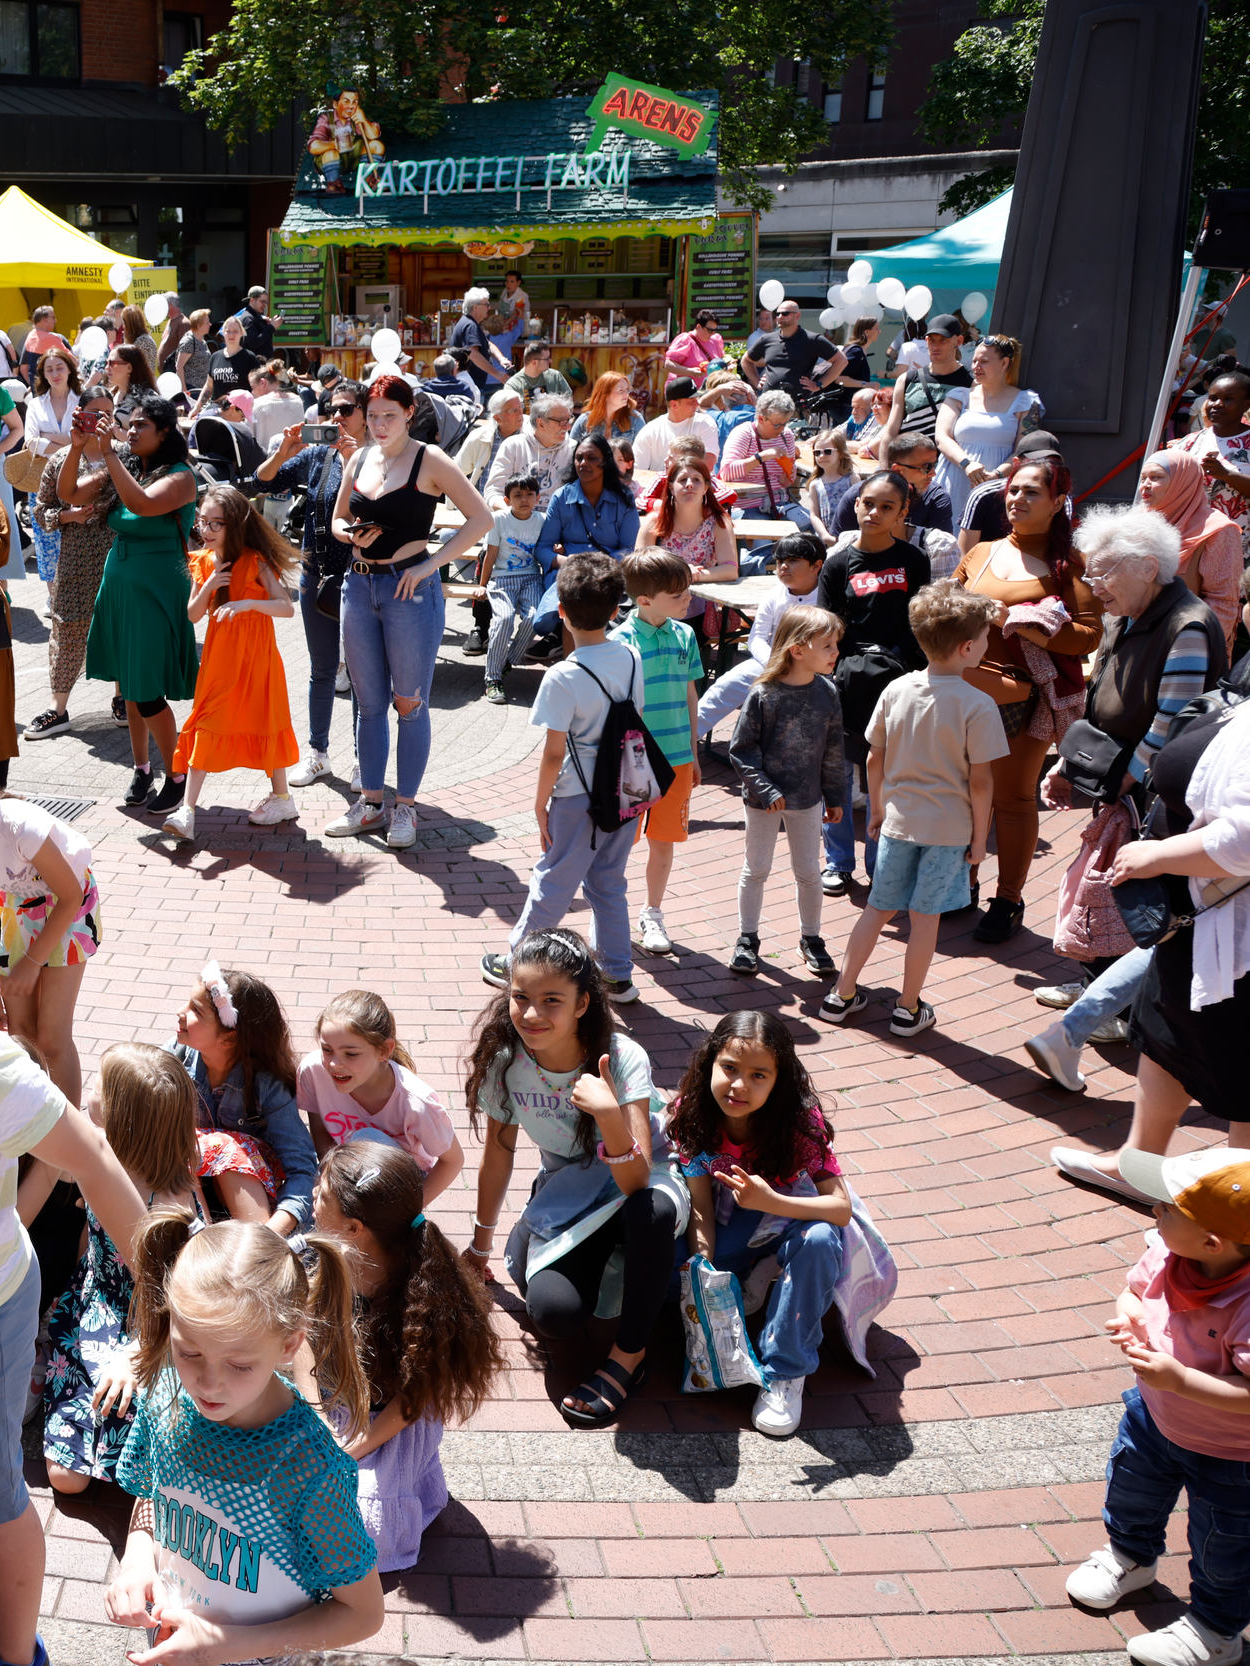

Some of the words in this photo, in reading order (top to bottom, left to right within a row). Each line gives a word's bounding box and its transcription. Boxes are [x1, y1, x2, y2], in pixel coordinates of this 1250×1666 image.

[602, 87, 704, 144] ARENS
[355, 156, 530, 198] KARTOFFEL
[544, 150, 632, 190] FARM
[66, 266, 104, 277] AMNESTY
[133, 279, 151, 288] BITTE
[512, 1092, 561, 1110] WILD
[153, 1489, 263, 1594] ROOKLYN
